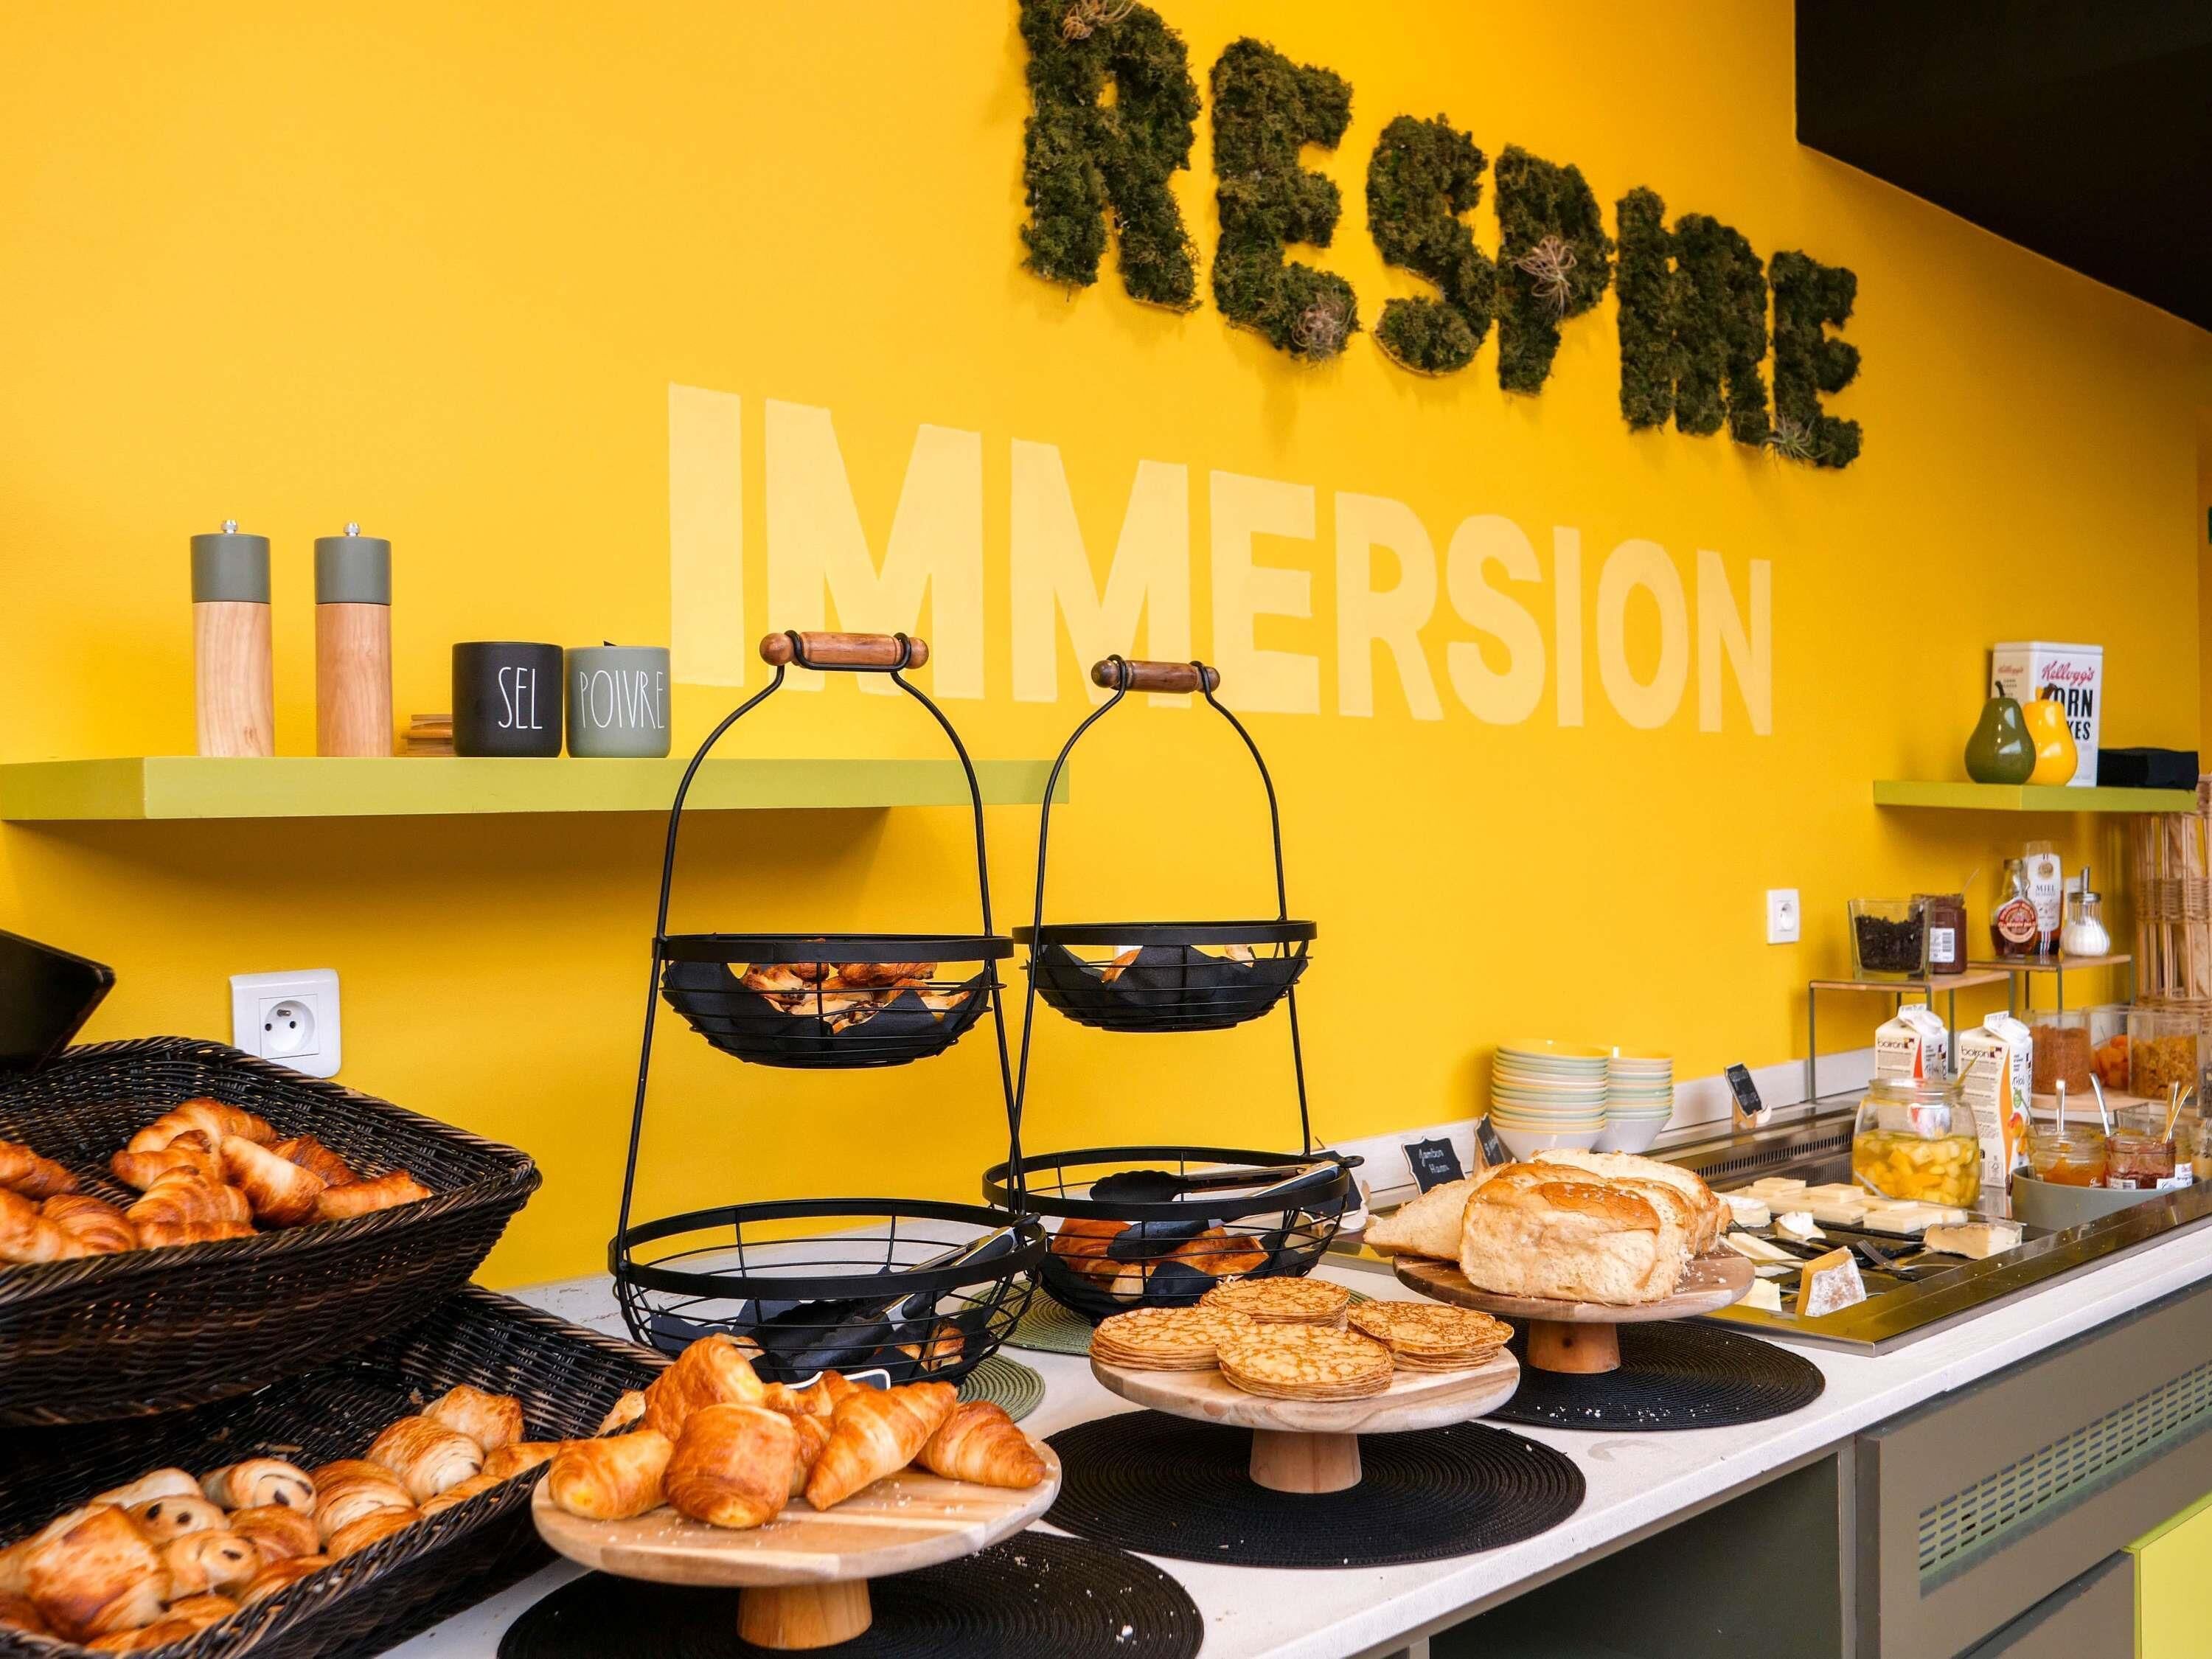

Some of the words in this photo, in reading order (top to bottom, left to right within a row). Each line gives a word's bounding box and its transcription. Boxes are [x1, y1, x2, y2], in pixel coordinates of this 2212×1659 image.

[668, 382, 1773, 737] IMMERSION
[498, 667, 543, 729] SEL
[580, 669, 665, 729] POIVRE
[2042, 661, 2096, 686] Kellogg's
[2053, 687, 2093, 718] ORN
